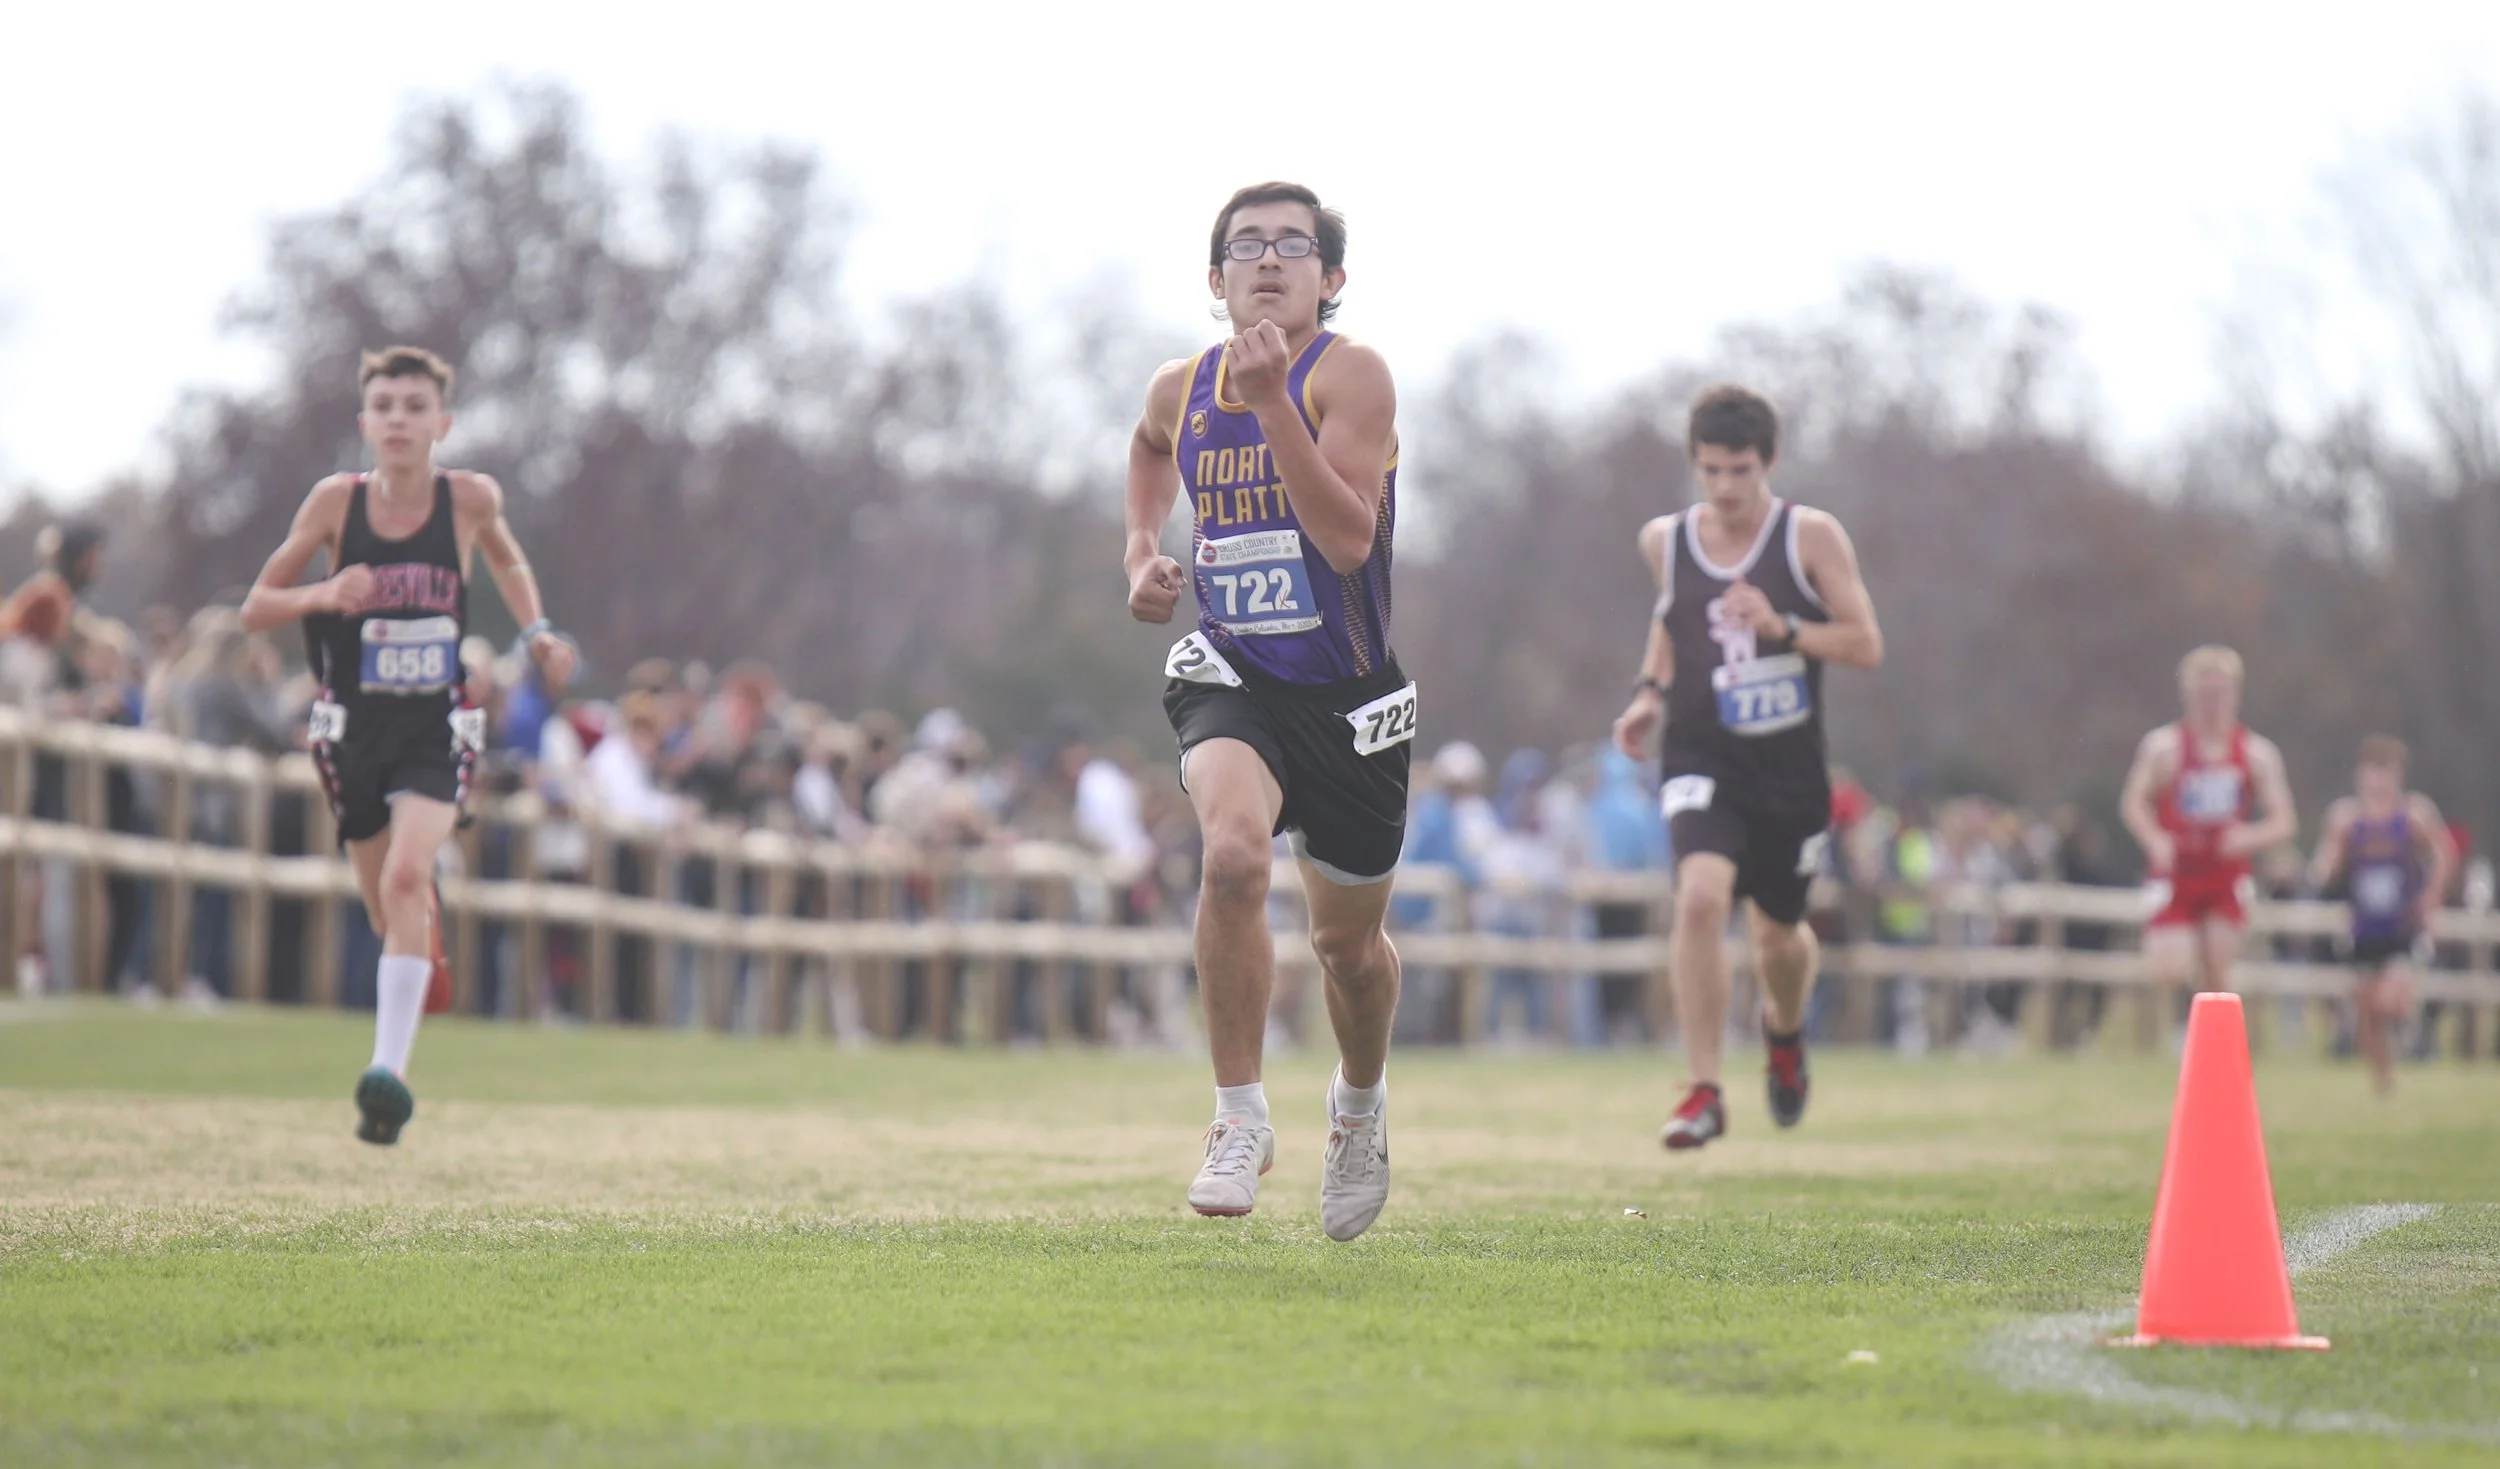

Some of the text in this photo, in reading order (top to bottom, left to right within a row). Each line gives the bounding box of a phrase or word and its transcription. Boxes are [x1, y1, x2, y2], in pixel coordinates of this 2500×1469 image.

[1197, 482, 1286, 526] PLATT
[1218, 536, 1278, 553] CROSS COUNTRY
[1212, 567, 1299, 615] 722
[376, 645, 446, 681] 658
[1366, 697, 1415, 744] 722
